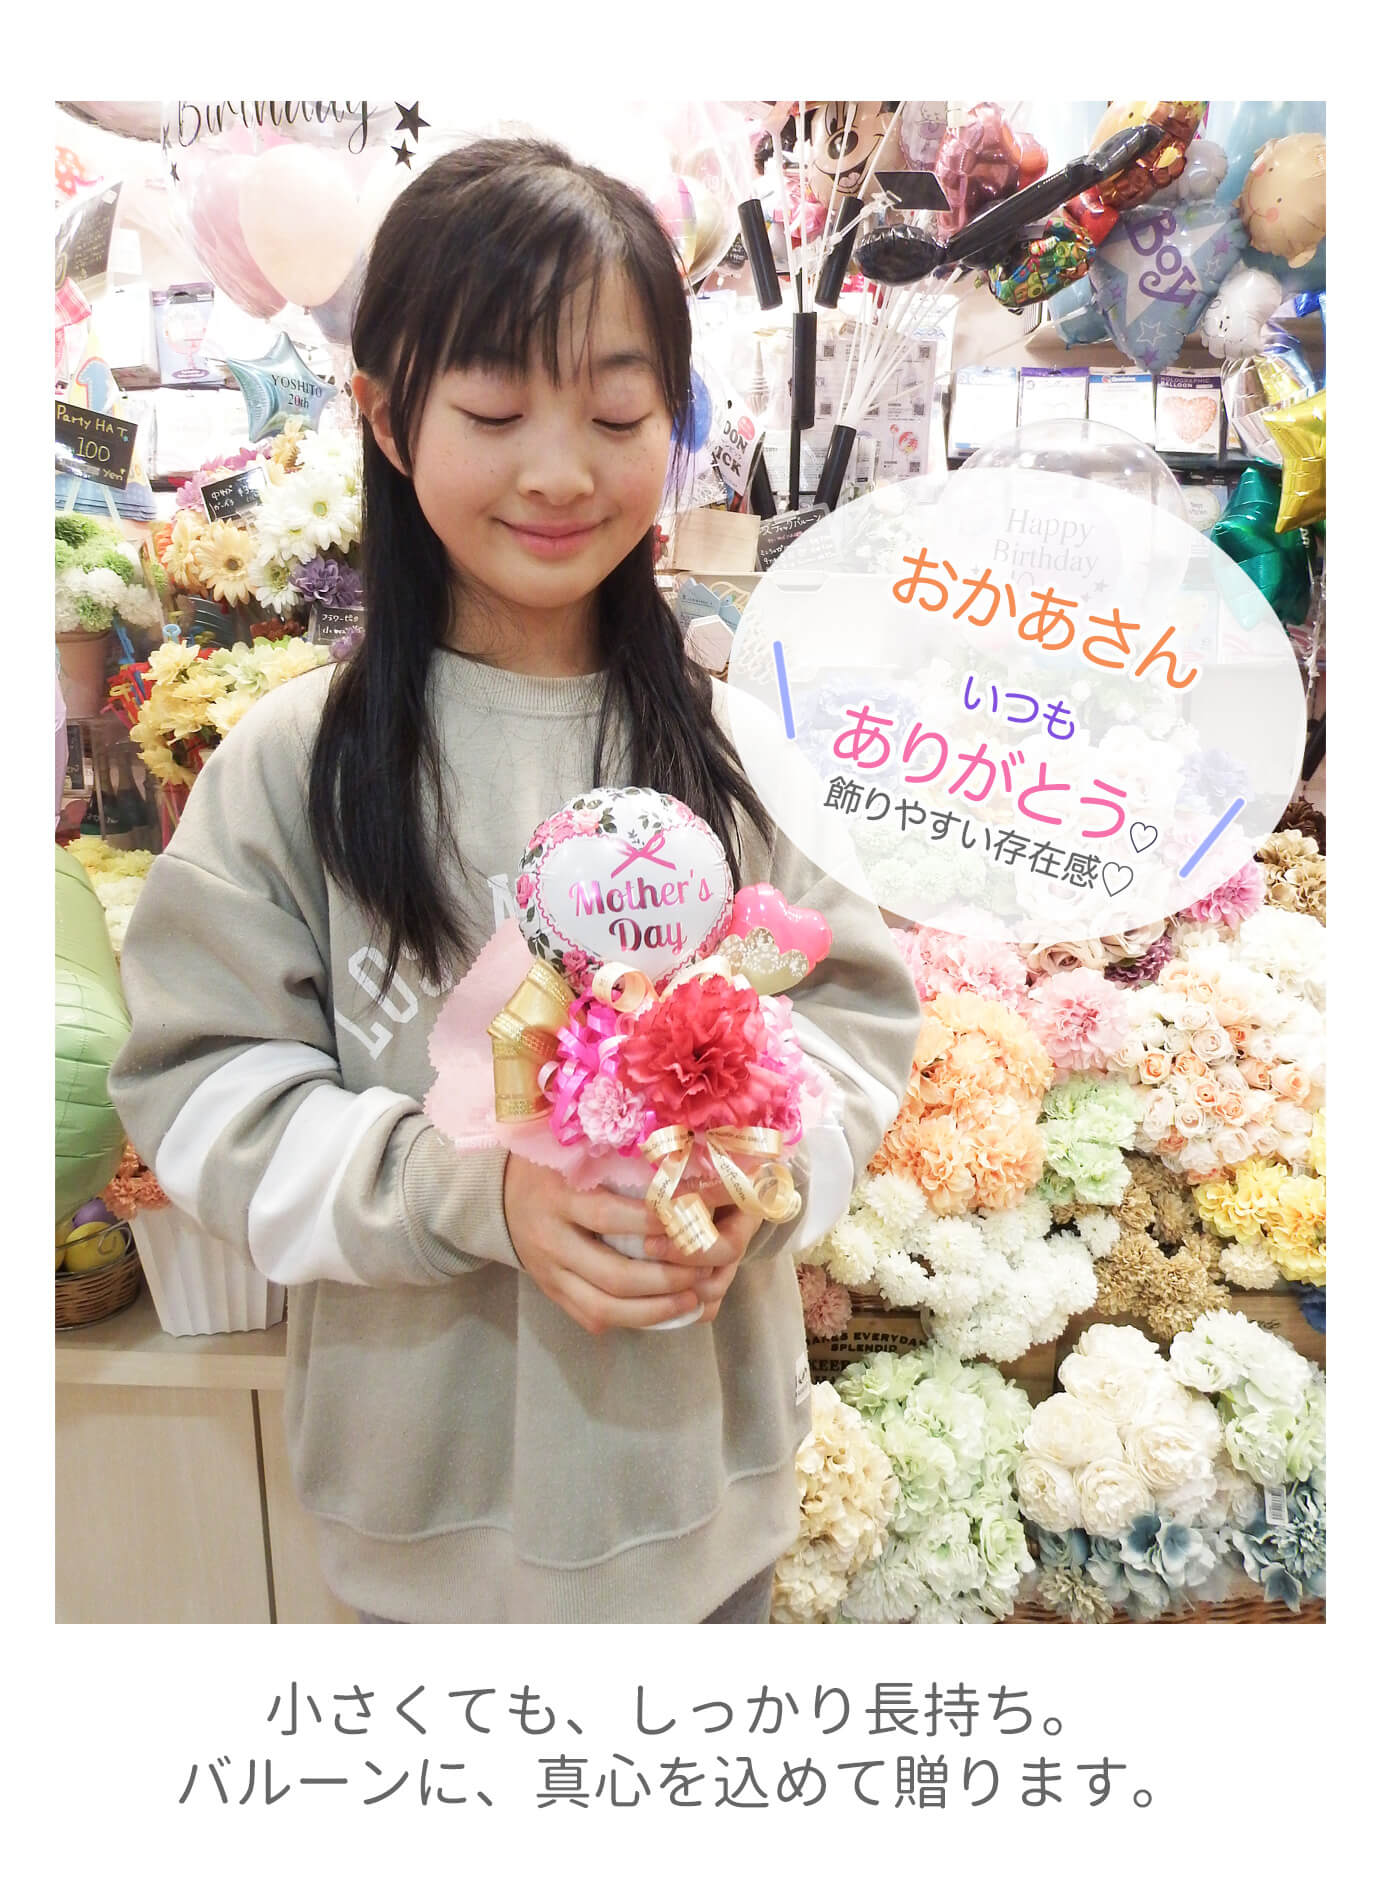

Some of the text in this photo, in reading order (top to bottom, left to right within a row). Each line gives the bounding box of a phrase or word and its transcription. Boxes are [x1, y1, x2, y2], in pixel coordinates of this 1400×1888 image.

[1126, 209, 1200, 309] Boy
[271, 374, 323, 399] YOSHITO
[287, 393, 310, 409] 20th
[56, 404, 92, 430] Party
[75, 436, 111, 462] 100
[1006, 508, 1096, 548] Happy
[993, 538, 1099, 579] Birthday
[568, 869, 714, 917] Mother's
[608, 917, 687, 955] Day
[831, 1343, 897, 1352] SPLENDID
